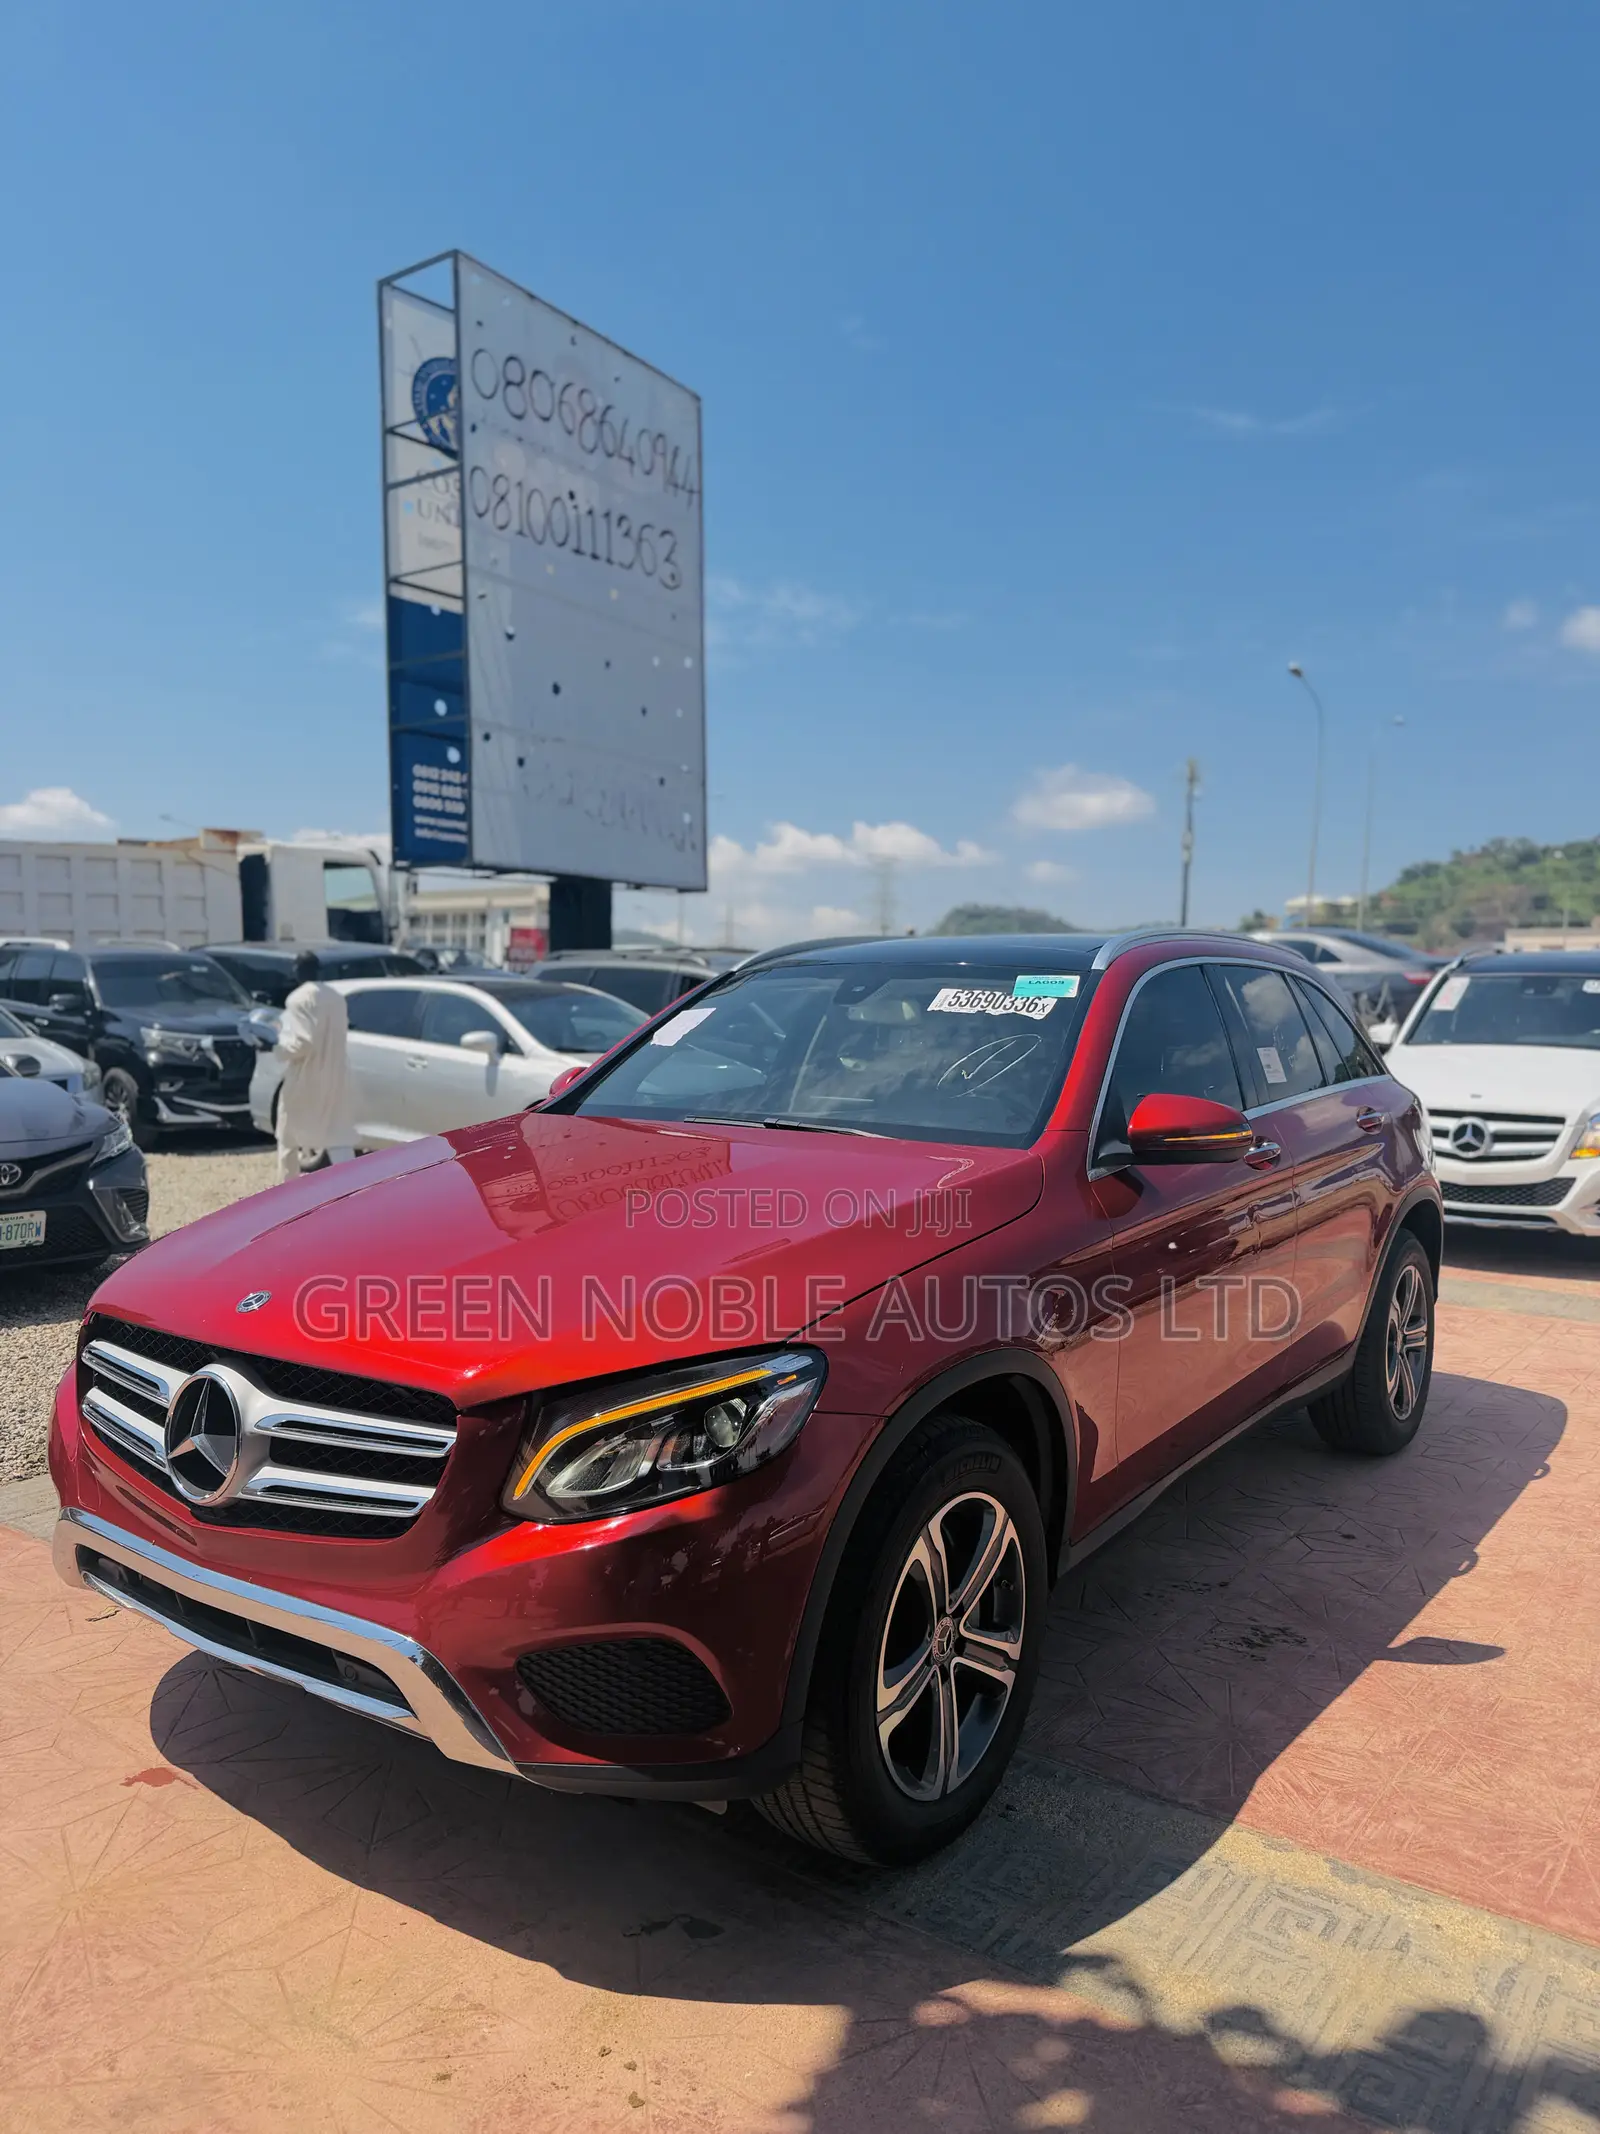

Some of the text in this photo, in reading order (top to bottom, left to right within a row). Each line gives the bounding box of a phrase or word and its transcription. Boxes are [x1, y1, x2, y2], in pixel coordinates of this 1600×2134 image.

[471, 348, 700, 511] 08068640944
[470, 466, 682, 590] 08100111363
[0, 1221, 42, 1241] -870RW
